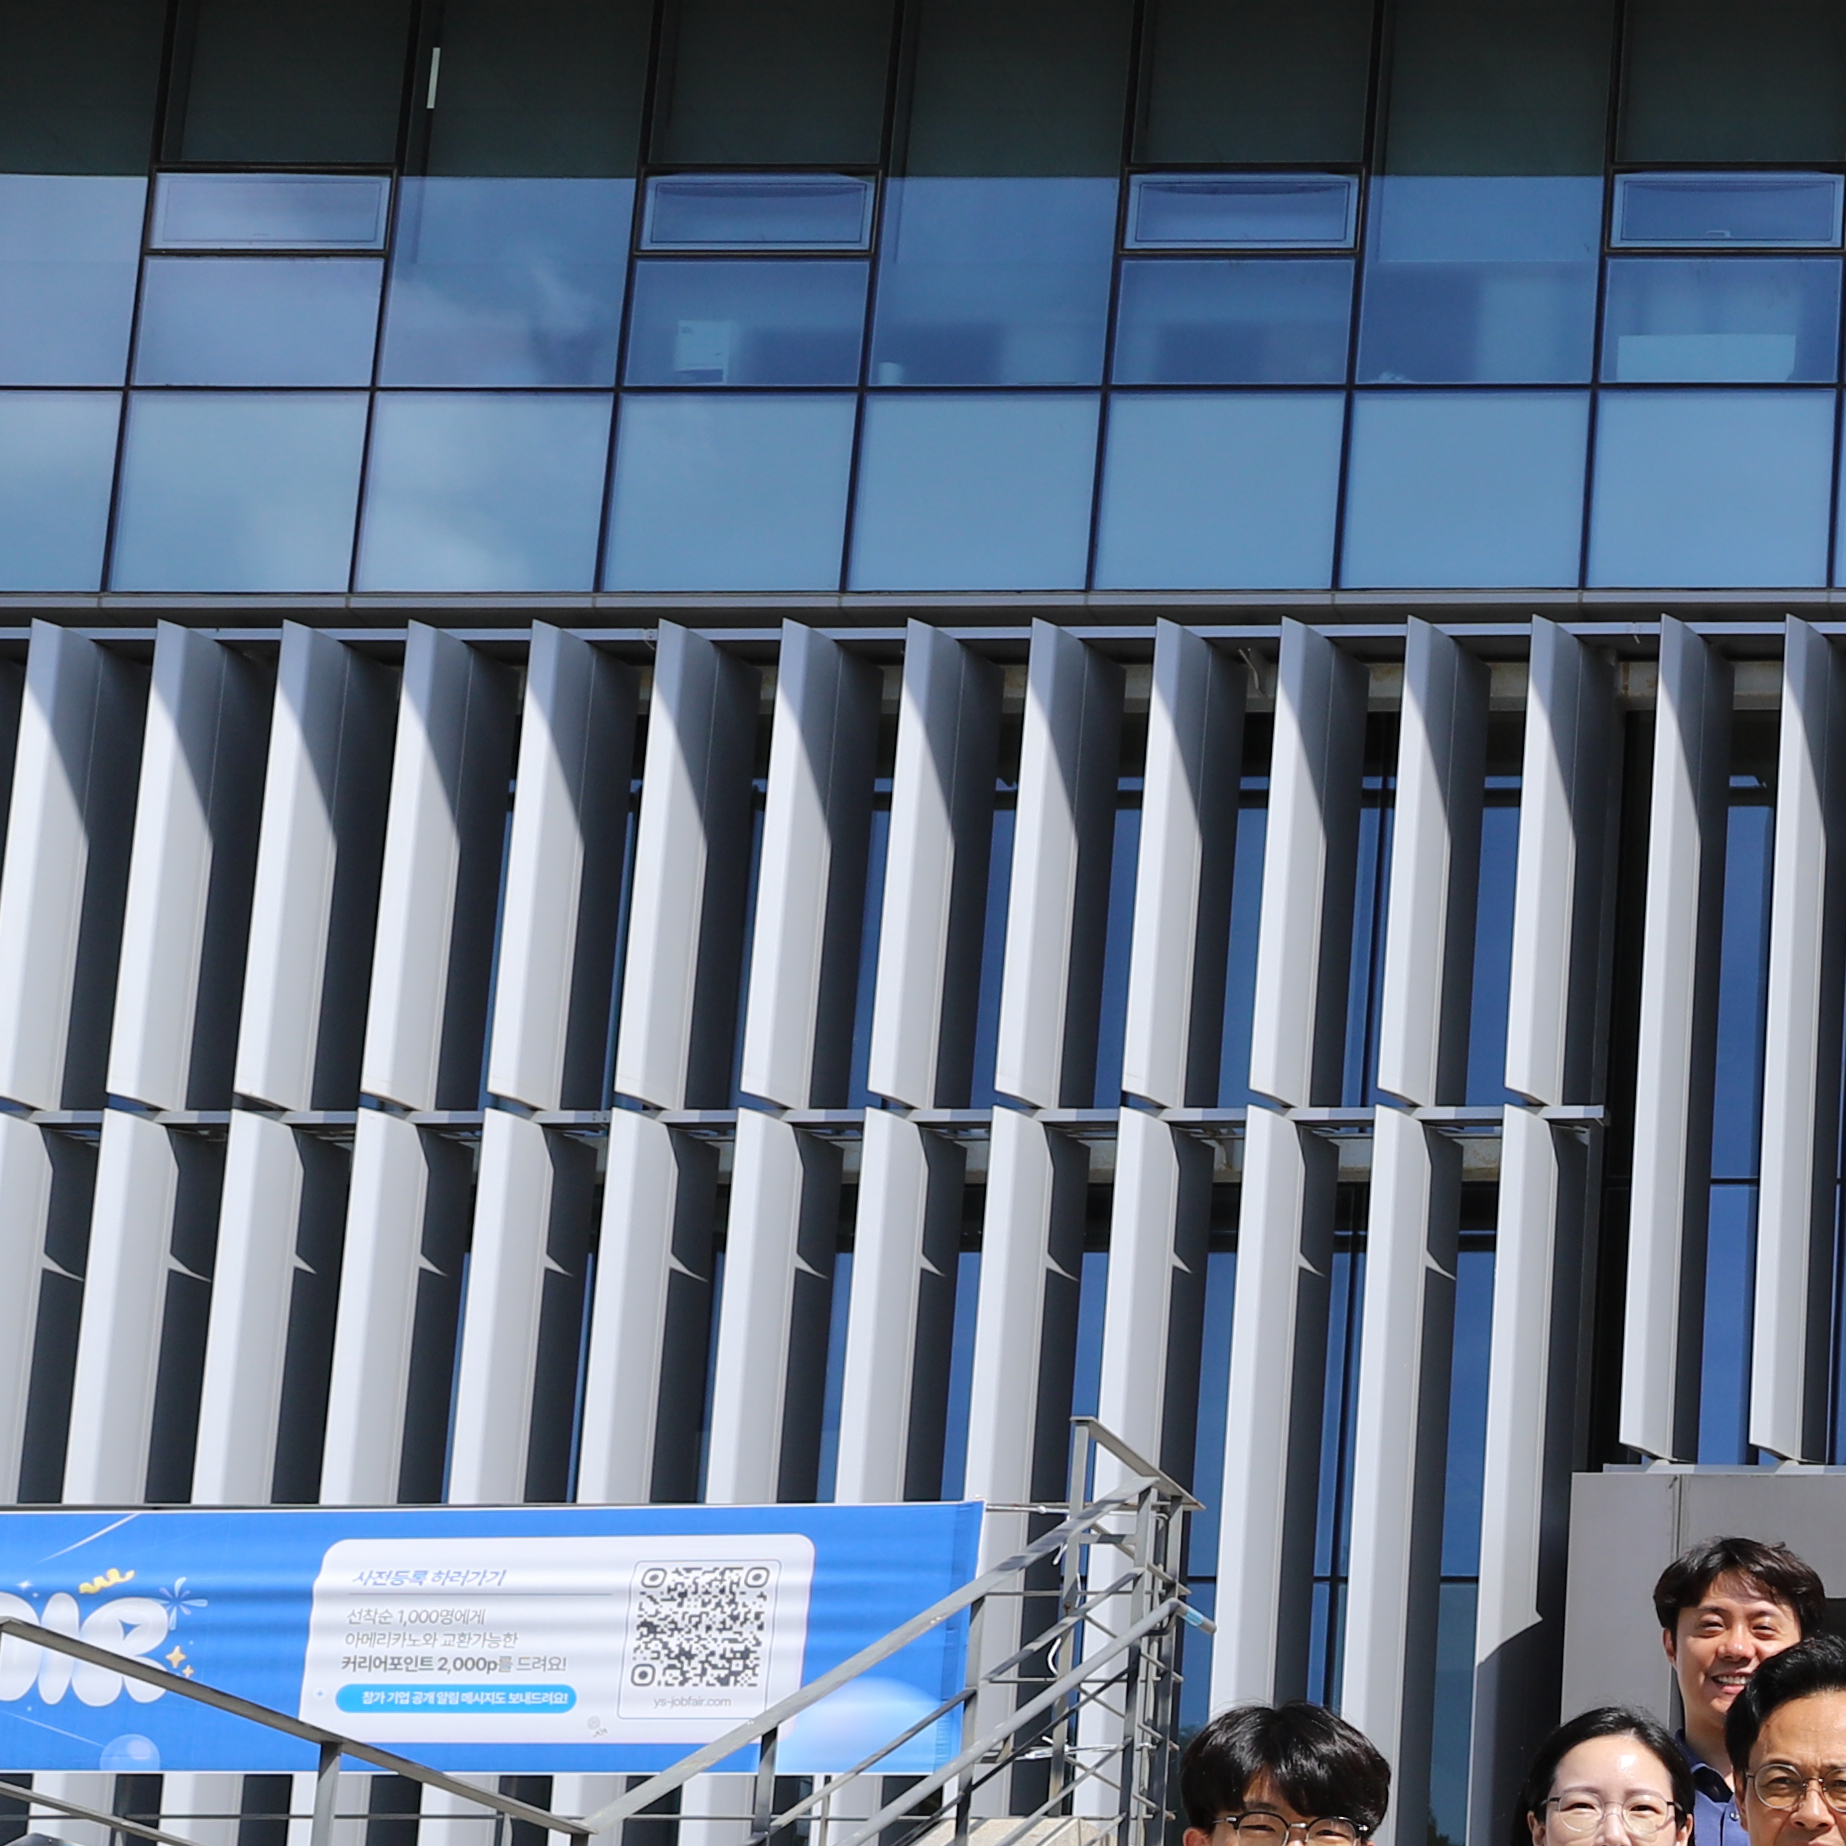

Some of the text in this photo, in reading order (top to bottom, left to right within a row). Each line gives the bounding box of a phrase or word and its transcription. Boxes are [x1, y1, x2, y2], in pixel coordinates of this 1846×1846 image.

[352, 1569, 507, 1587] 사전등록 하러가기
[346, 1608, 486, 1627] 선착순 1,000명에게
[345, 1632, 518, 1649] 아메리카노와 교환가능한
[341, 1655, 567, 1675] 커리어포인트 2,000p를 드려요!
[362, 1691, 568, 1705] 참가 기업 공개 알림 메시지도 보내드려요!
[653, 1695, 732, 1709] ys-jobfair.com
